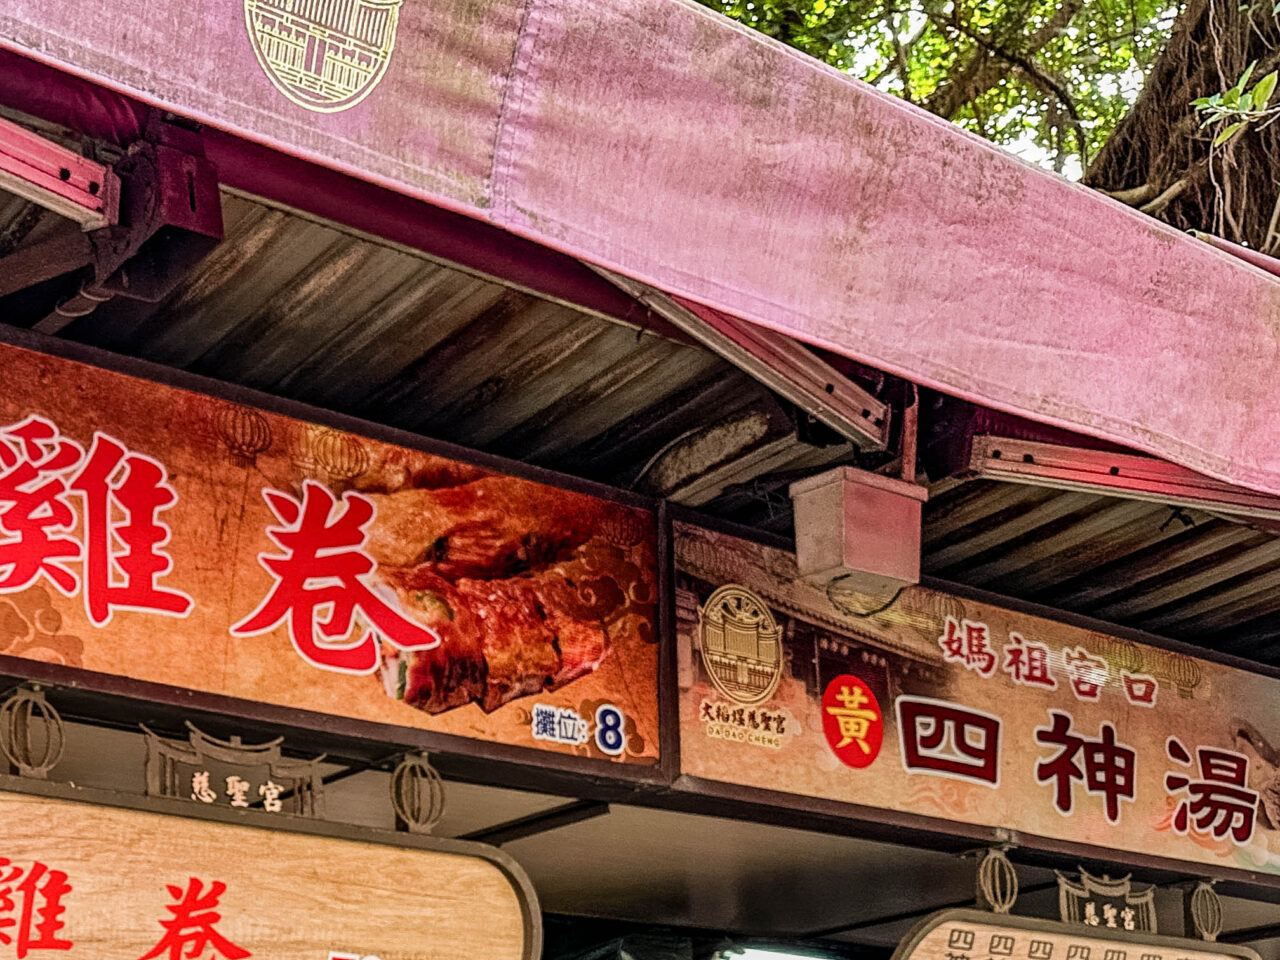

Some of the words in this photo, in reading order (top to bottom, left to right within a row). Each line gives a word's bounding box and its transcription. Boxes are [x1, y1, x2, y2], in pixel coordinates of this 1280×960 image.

[940, 614, 1160, 708] 媽祖宮口
[595, 703, 627, 754] 8
[702, 702, 786, 735] 大稻埕慈聖宮
[826, 685, 877, 755] 黃
[190, 770, 285, 813] 慈聖宮
[895, 694, 1261, 845] 四神湯
[1083, 901, 1136, 931] 慈聖宮
